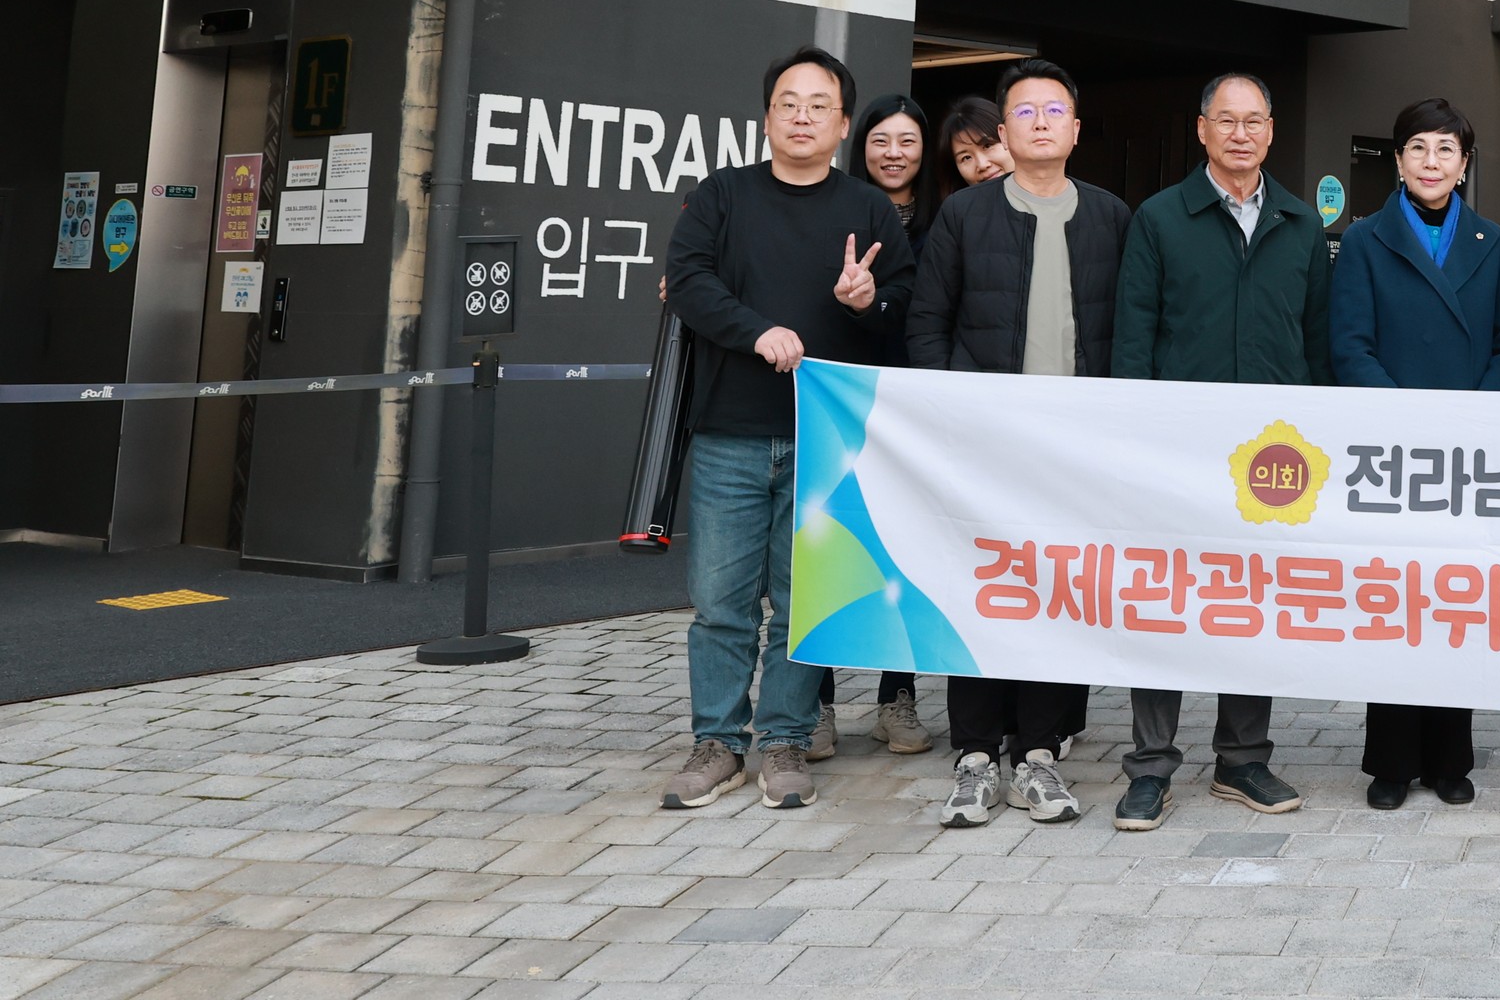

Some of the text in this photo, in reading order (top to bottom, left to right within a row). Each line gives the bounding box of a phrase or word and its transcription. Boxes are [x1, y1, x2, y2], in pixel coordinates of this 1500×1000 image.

[305, 57, 339, 110] 1F
[472, 93, 772, 193] ENTRAN
[536, 217, 653, 299] 입구
[1251, 463, 1304, 491] 의회
